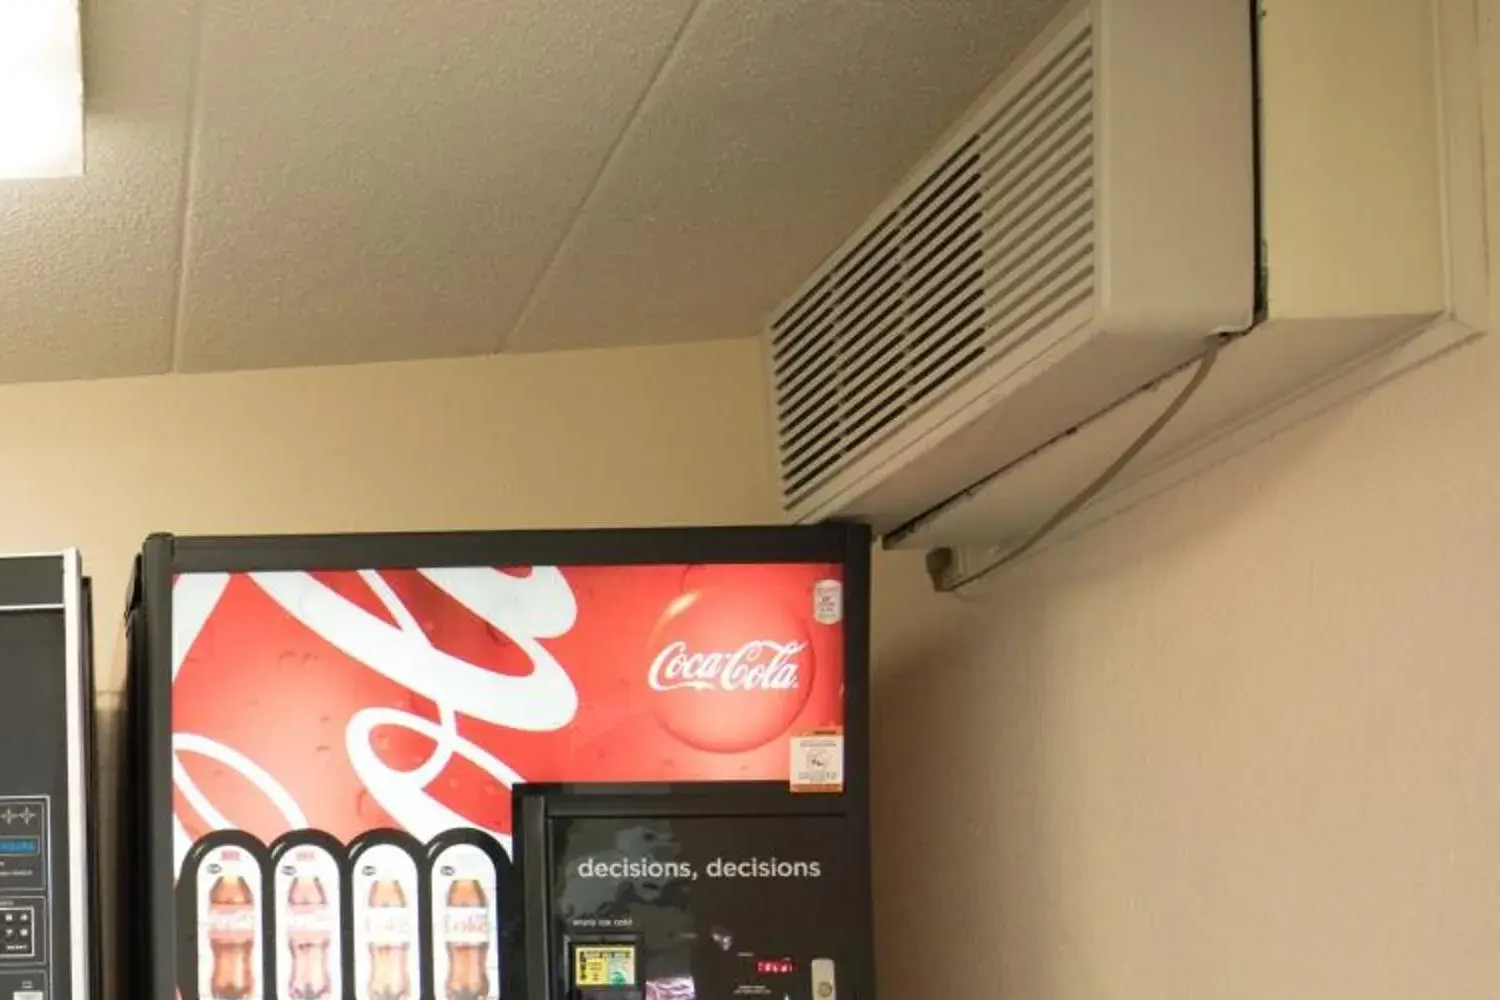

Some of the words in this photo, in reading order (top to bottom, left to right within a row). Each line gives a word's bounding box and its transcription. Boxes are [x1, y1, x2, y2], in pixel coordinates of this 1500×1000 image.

[648, 640, 806, 691] Coca-Cola
[578, 857, 698, 881] decisions,
[706, 857, 821, 878] decisions
